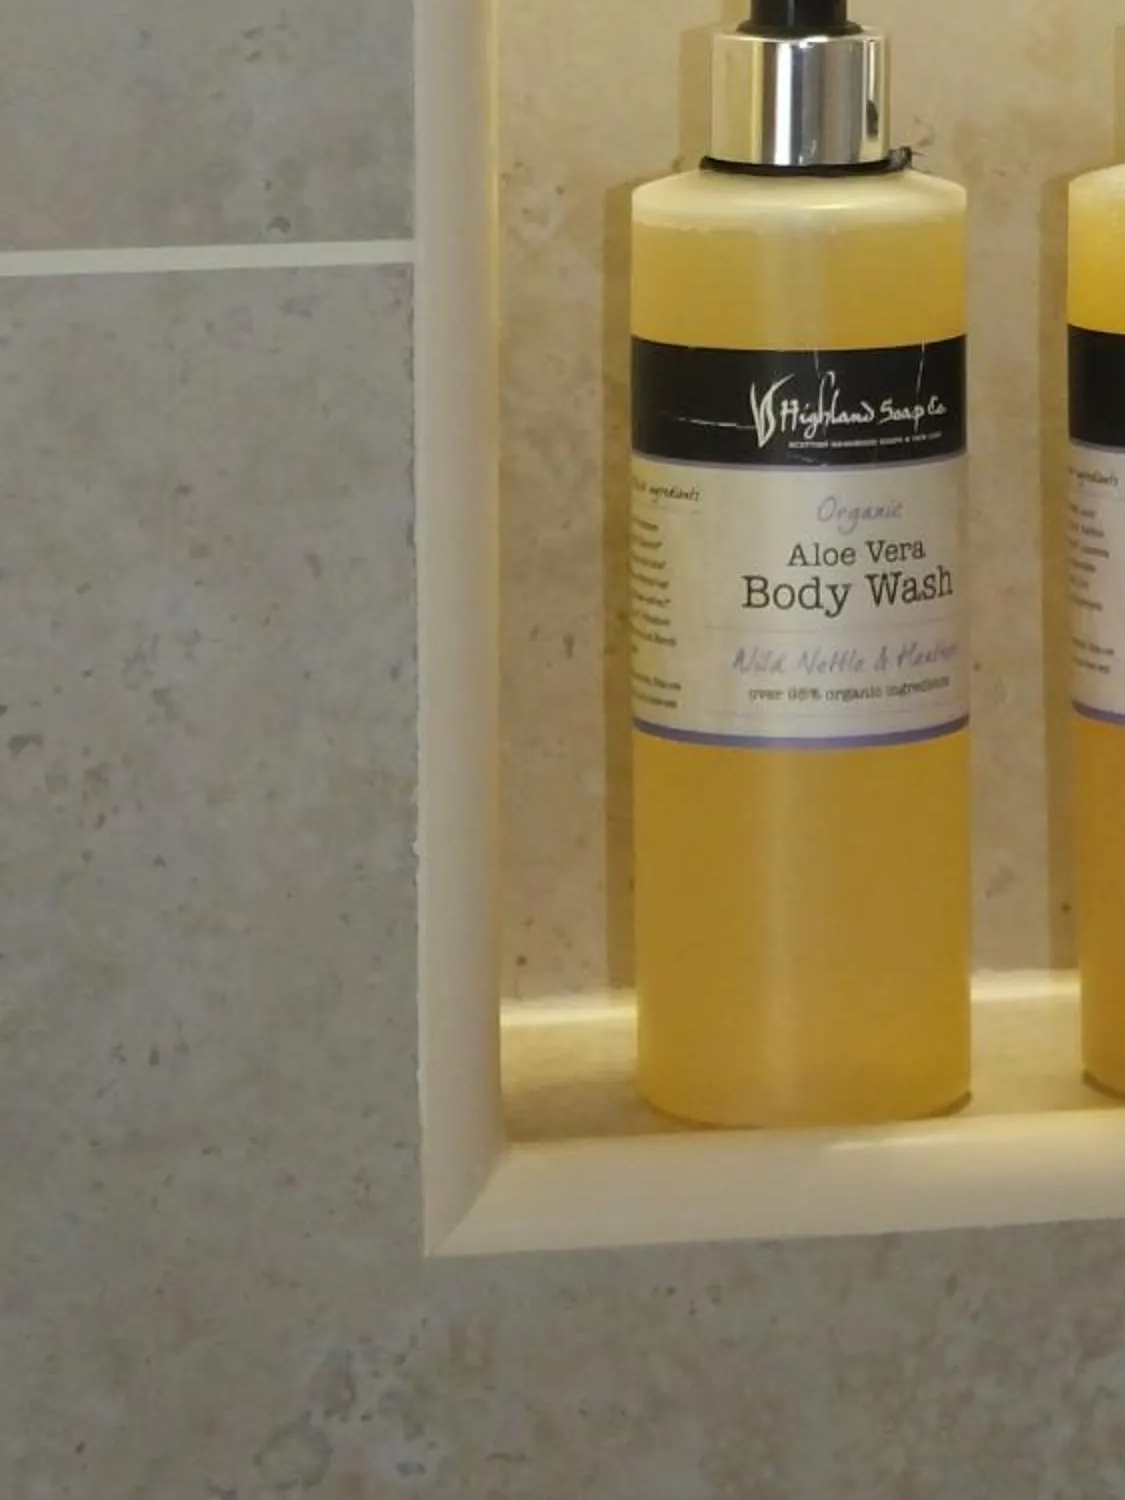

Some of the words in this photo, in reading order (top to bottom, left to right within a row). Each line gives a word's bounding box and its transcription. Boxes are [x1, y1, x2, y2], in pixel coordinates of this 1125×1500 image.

[780, 371, 875, 439] Highland
[879, 398, 925, 432] Soap
[817, 496, 903, 535] Organic
[786, 542, 857, 567] Aloe
[864, 539, 926, 563] Vera
[741, 574, 852, 618] Body
[864, 564, 953, 607] Wash
[748, 688, 784, 702] over
[824, 686, 883, 703] organic
